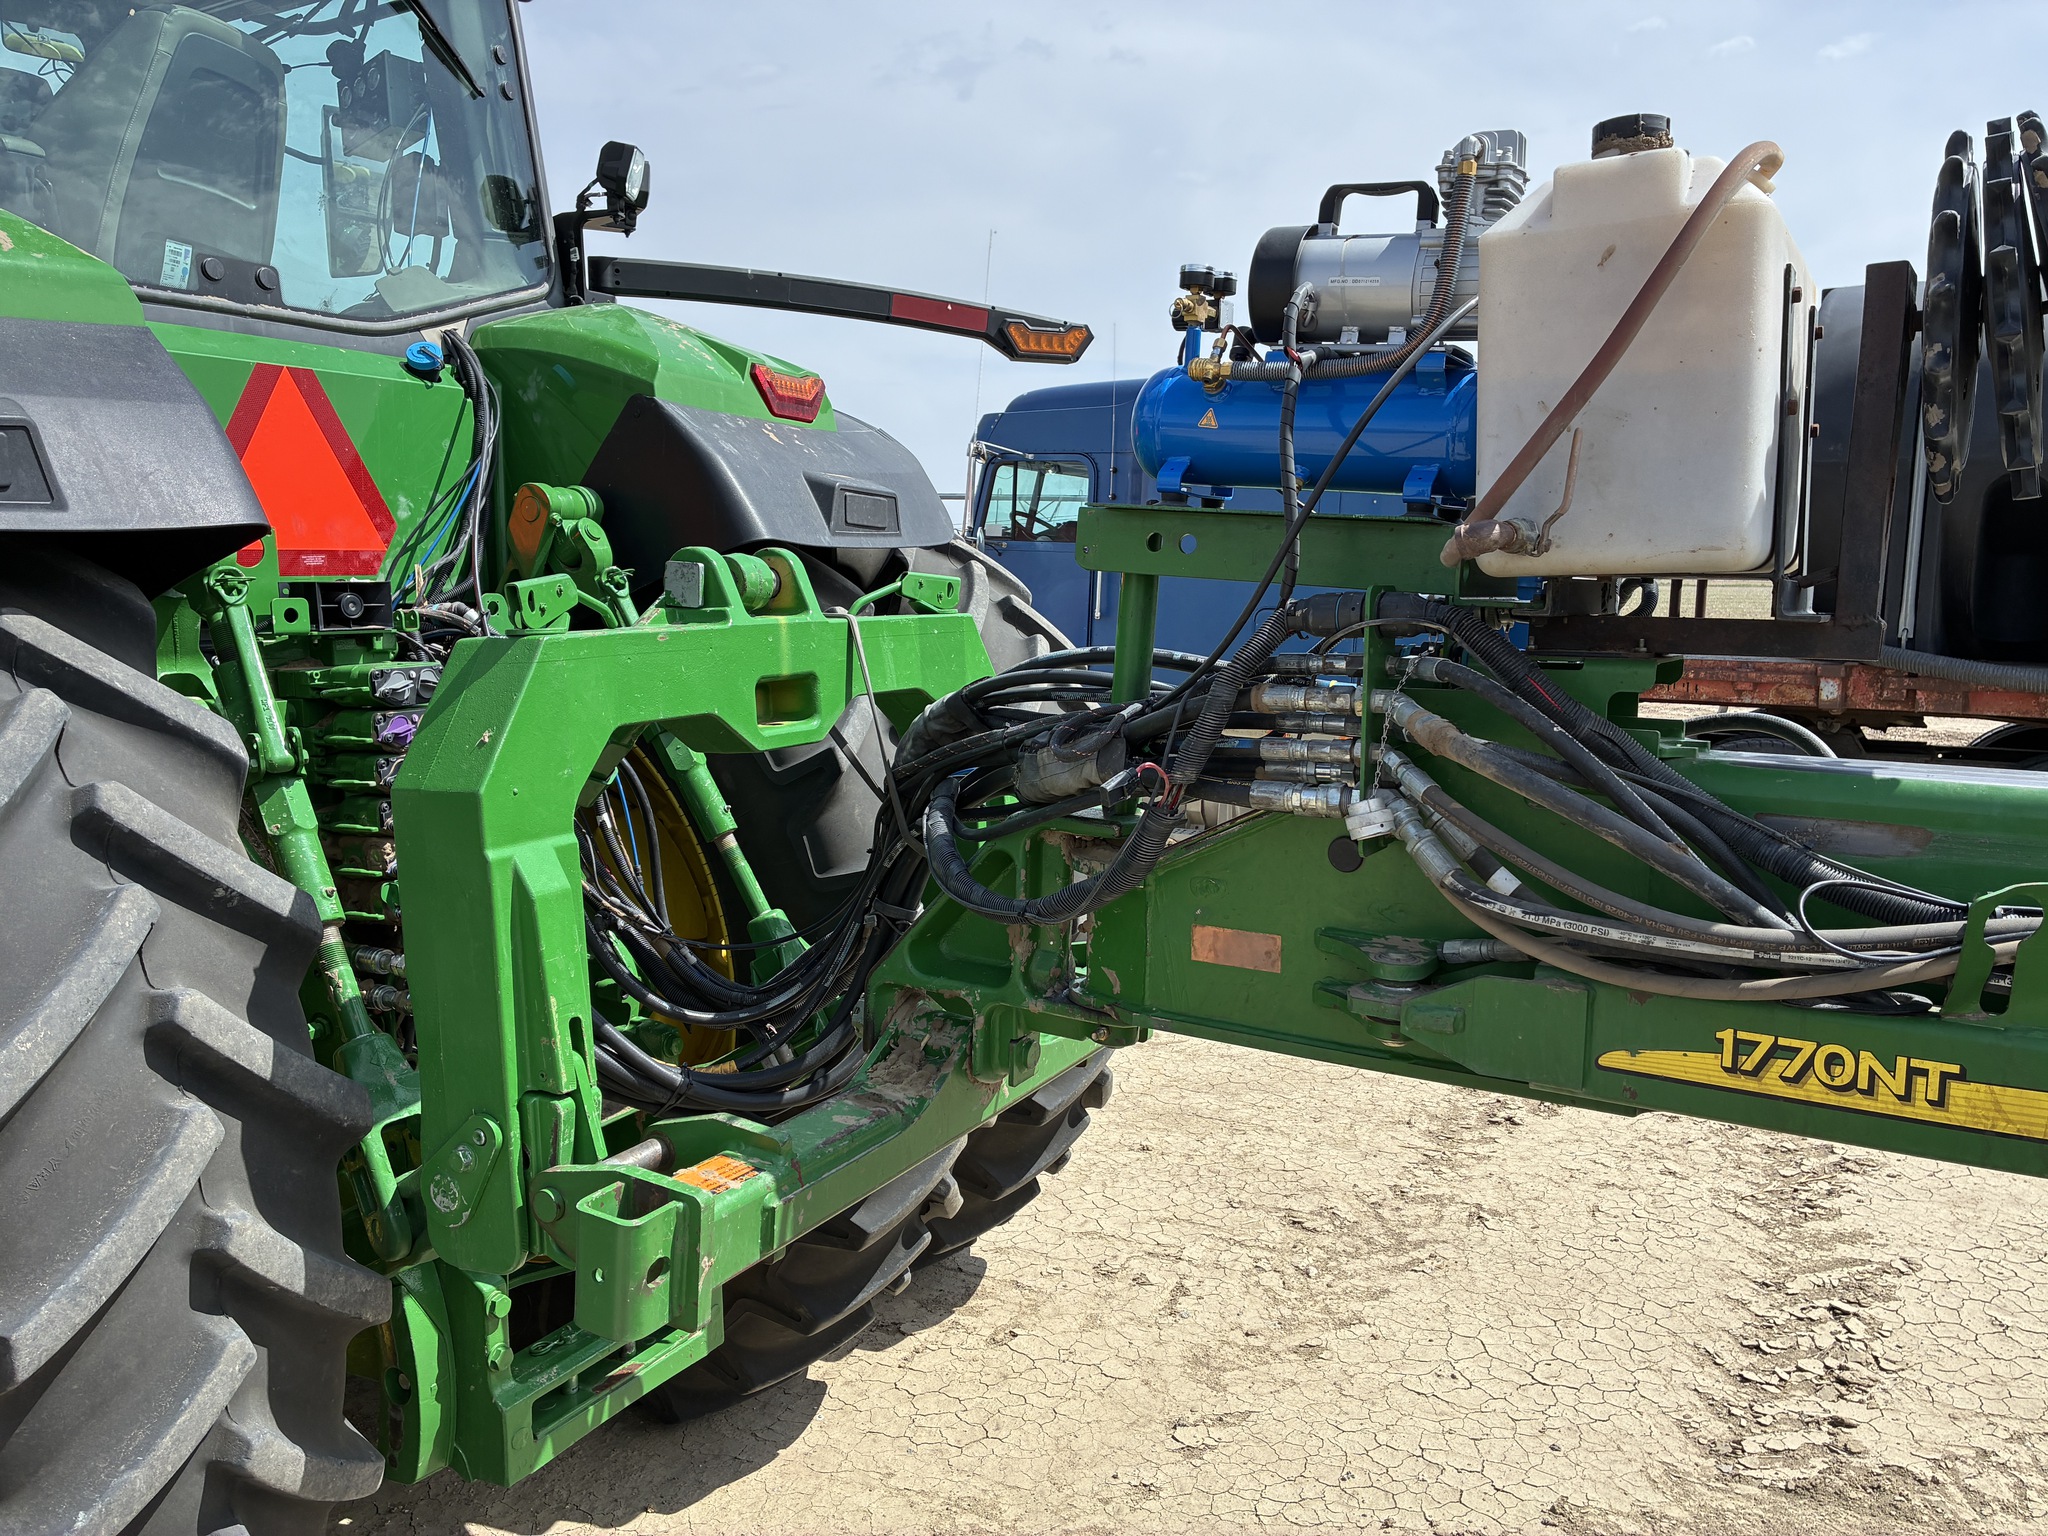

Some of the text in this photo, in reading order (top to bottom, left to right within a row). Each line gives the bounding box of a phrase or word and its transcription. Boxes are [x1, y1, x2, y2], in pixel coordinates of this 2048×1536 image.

[1542, 915, 1561, 928] MPa
[1563, 919, 1589, 934] (3000
[1590, 925, 1610, 937] PSI)
[1645, 919, 1676, 936] MSHA
[1676, 926, 1702, 941] PSI)
[1729, 937, 1756, 949] MPa
[1778, 942, 1796, 952] WP
[1755, 951, 1781, 961] Parker
[1715, 1027, 1966, 1109] 1770NT
